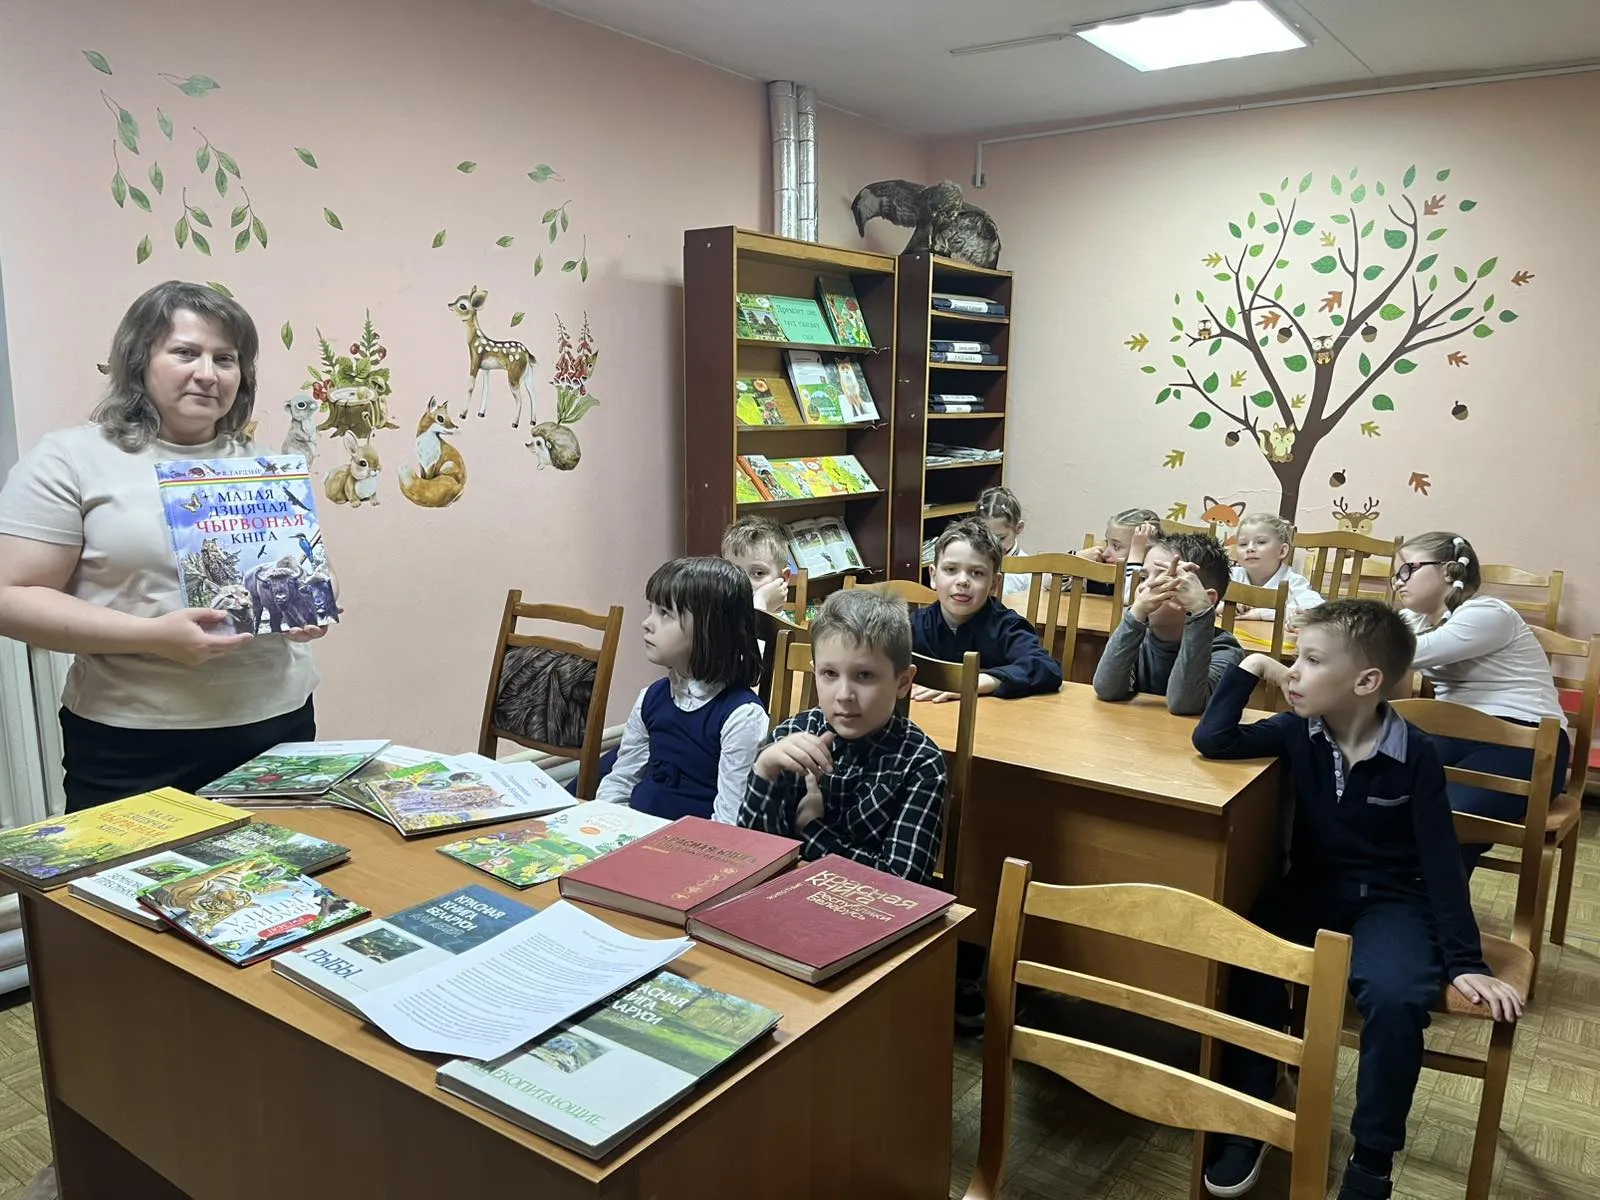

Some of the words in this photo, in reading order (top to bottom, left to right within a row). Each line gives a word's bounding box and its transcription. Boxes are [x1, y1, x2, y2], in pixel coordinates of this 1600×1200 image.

[217, 488, 274, 502] МАЛАЯ
[196, 514, 304, 533] ЧЫРВОНАЯ
[231, 531, 278, 544] КНІГА
[425, 906, 479, 932] БЕЛАРУСИ
[439, 900, 479, 921] КНИГА
[453, 894, 507, 920] КРАСНАЯ
[806, 890, 893, 922] Республики
[303, 948, 364, 979] РЫБЫ
[633, 981, 690, 1008] АСНАЯ
